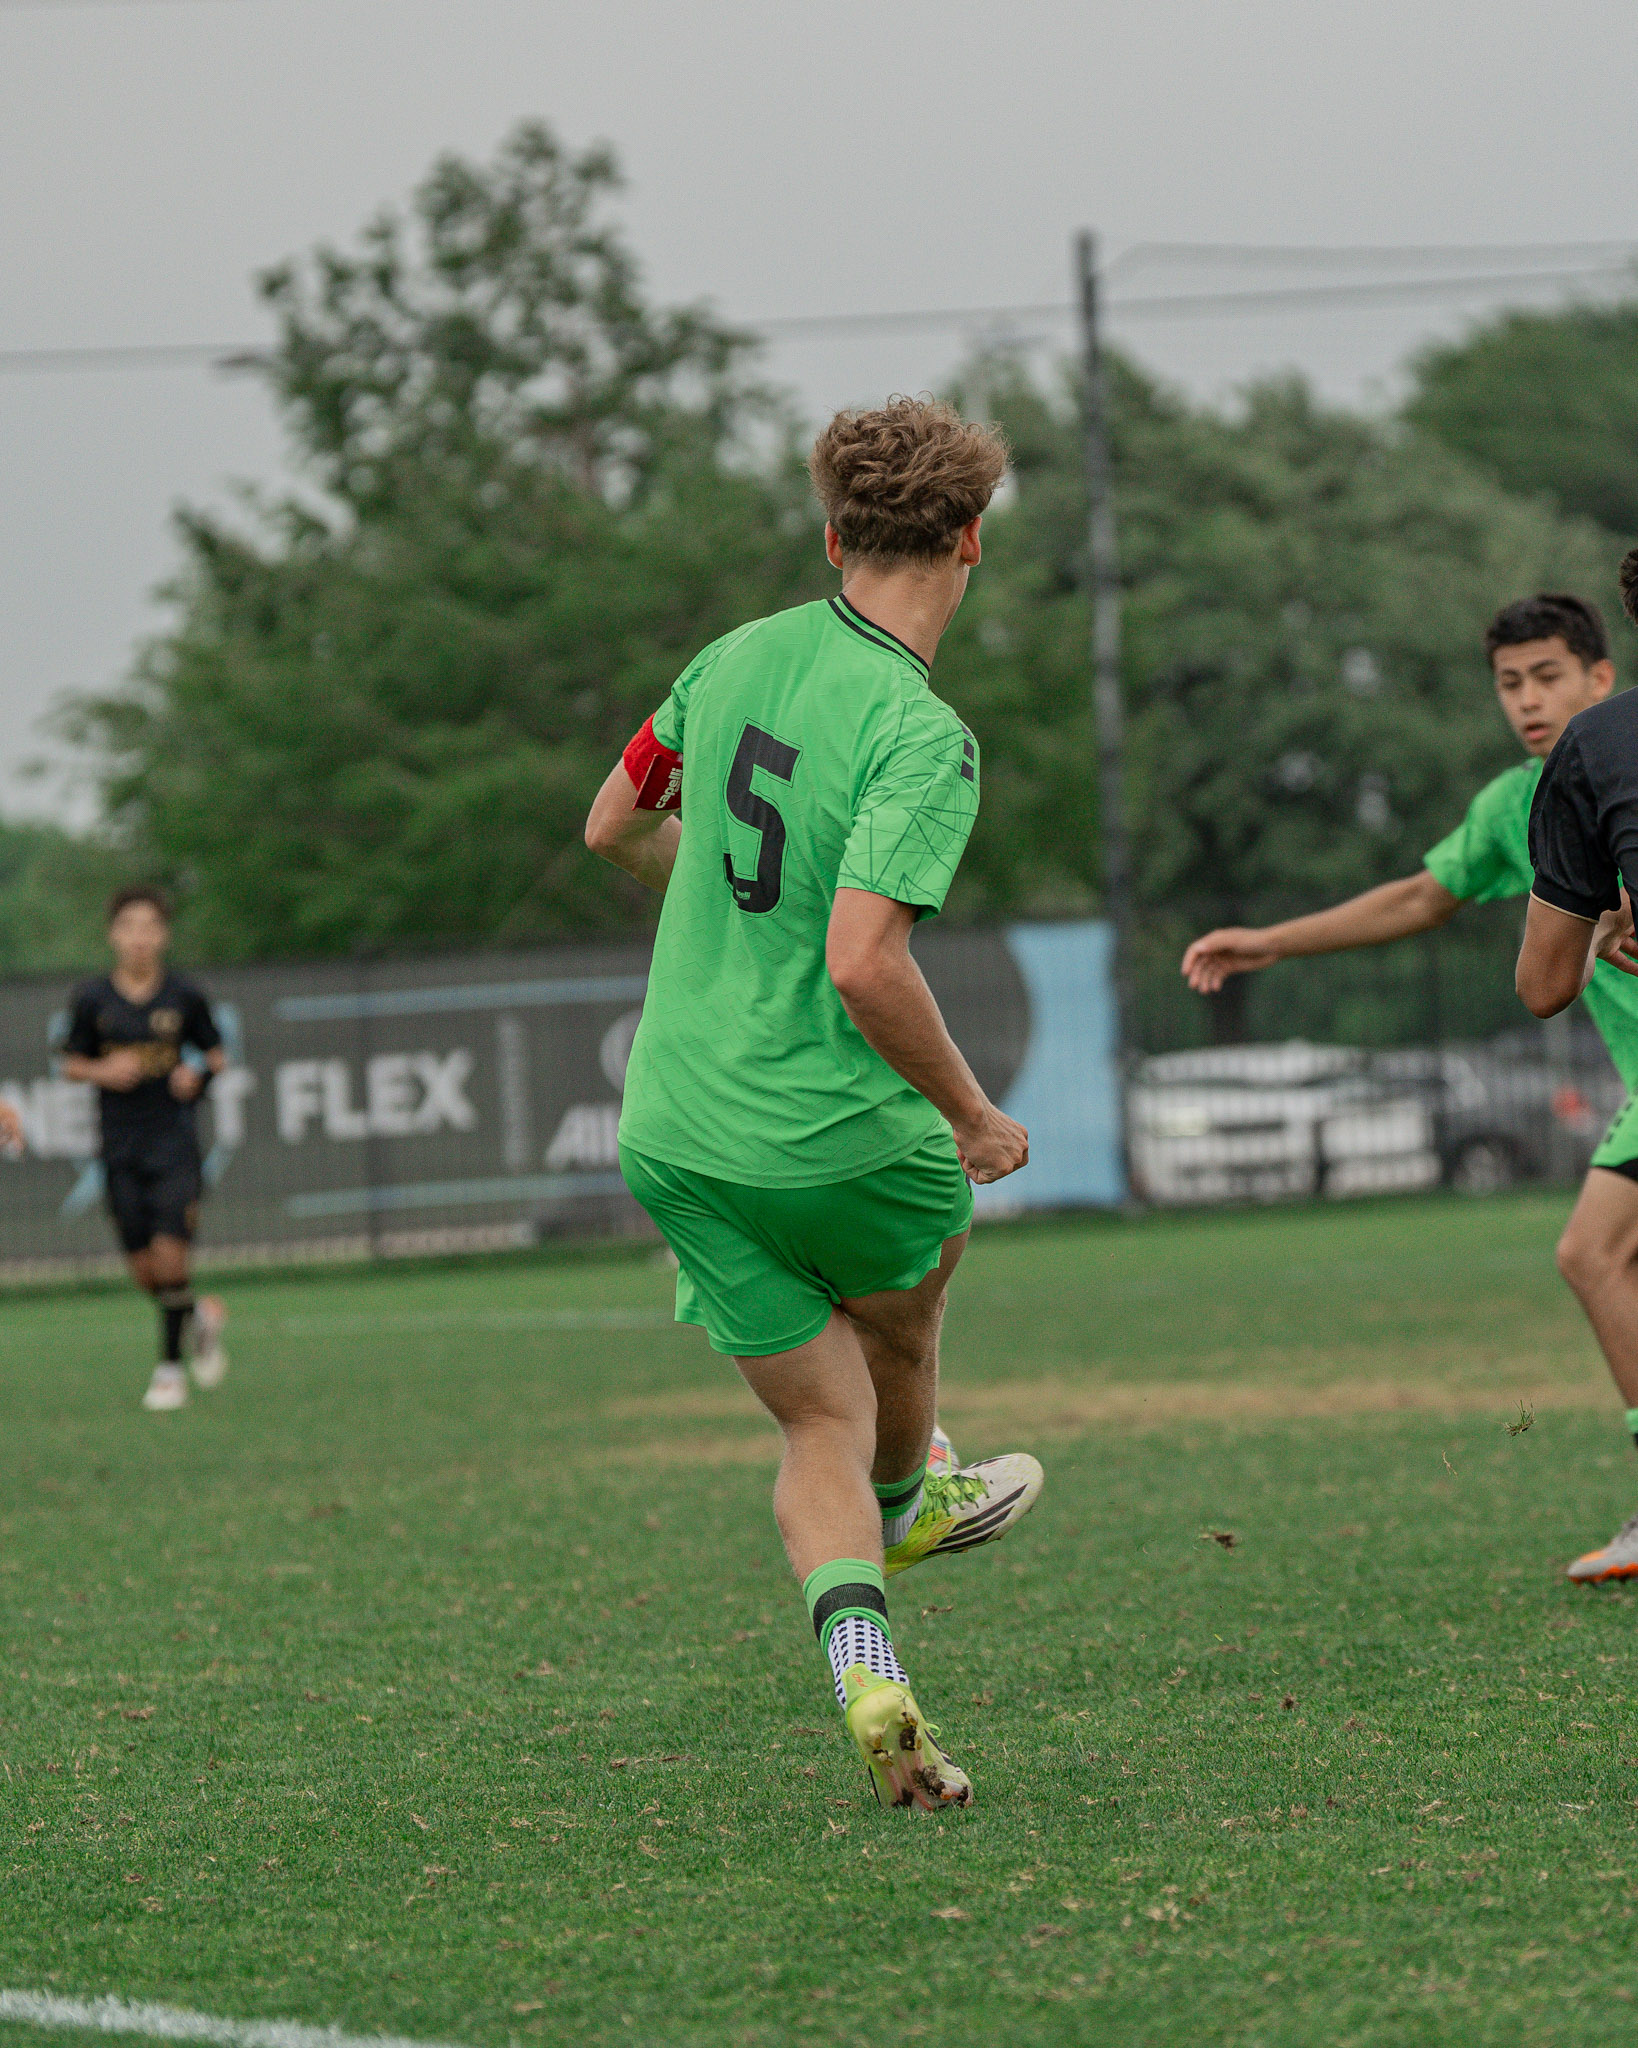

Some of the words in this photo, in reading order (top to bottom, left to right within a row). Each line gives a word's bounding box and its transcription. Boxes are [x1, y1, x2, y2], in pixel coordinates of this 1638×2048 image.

[655, 767, 683, 809] capelli
[723, 722, 801, 914] 5
[0, 1070, 257, 1160] NET
[275, 1049, 477, 1143] FLEX
